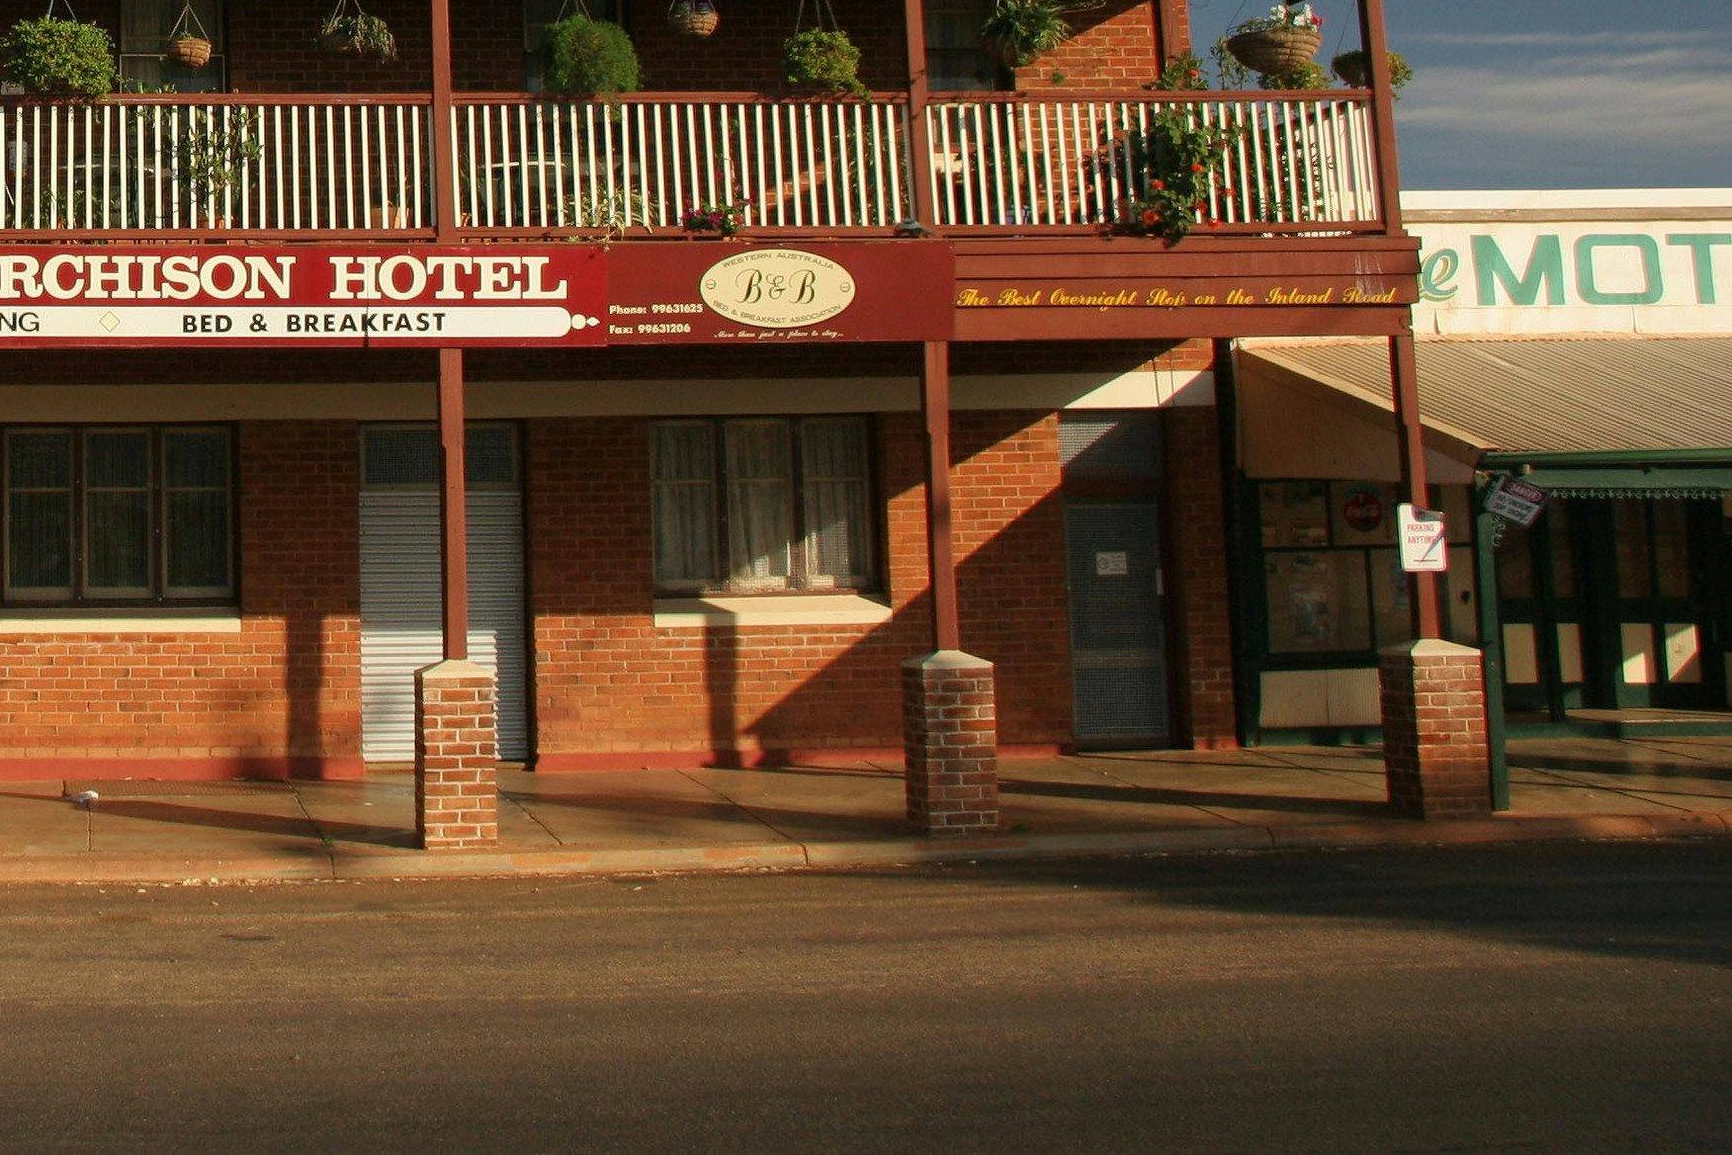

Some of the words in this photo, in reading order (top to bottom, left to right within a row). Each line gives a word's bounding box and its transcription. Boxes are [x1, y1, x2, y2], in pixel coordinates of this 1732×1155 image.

[329, 255, 567, 300] HOTEL
[609, 305, 647, 315] Phone:
[957, 288, 989, 306] The
[998, 288, 1041, 306] Best
[1050, 287, 1136, 311] Overnight
[1147, 288, 1186, 311] Stop
[1194, 293, 1216, 305] on
[1225, 288, 1254, 305] the
[1264, 286, 1332, 304] Inland
[1341, 286, 1397, 304] Road
[183, 314, 232, 333] BED
[250, 314, 267, 332] &
[287, 312, 446, 332] BREAKFAST
